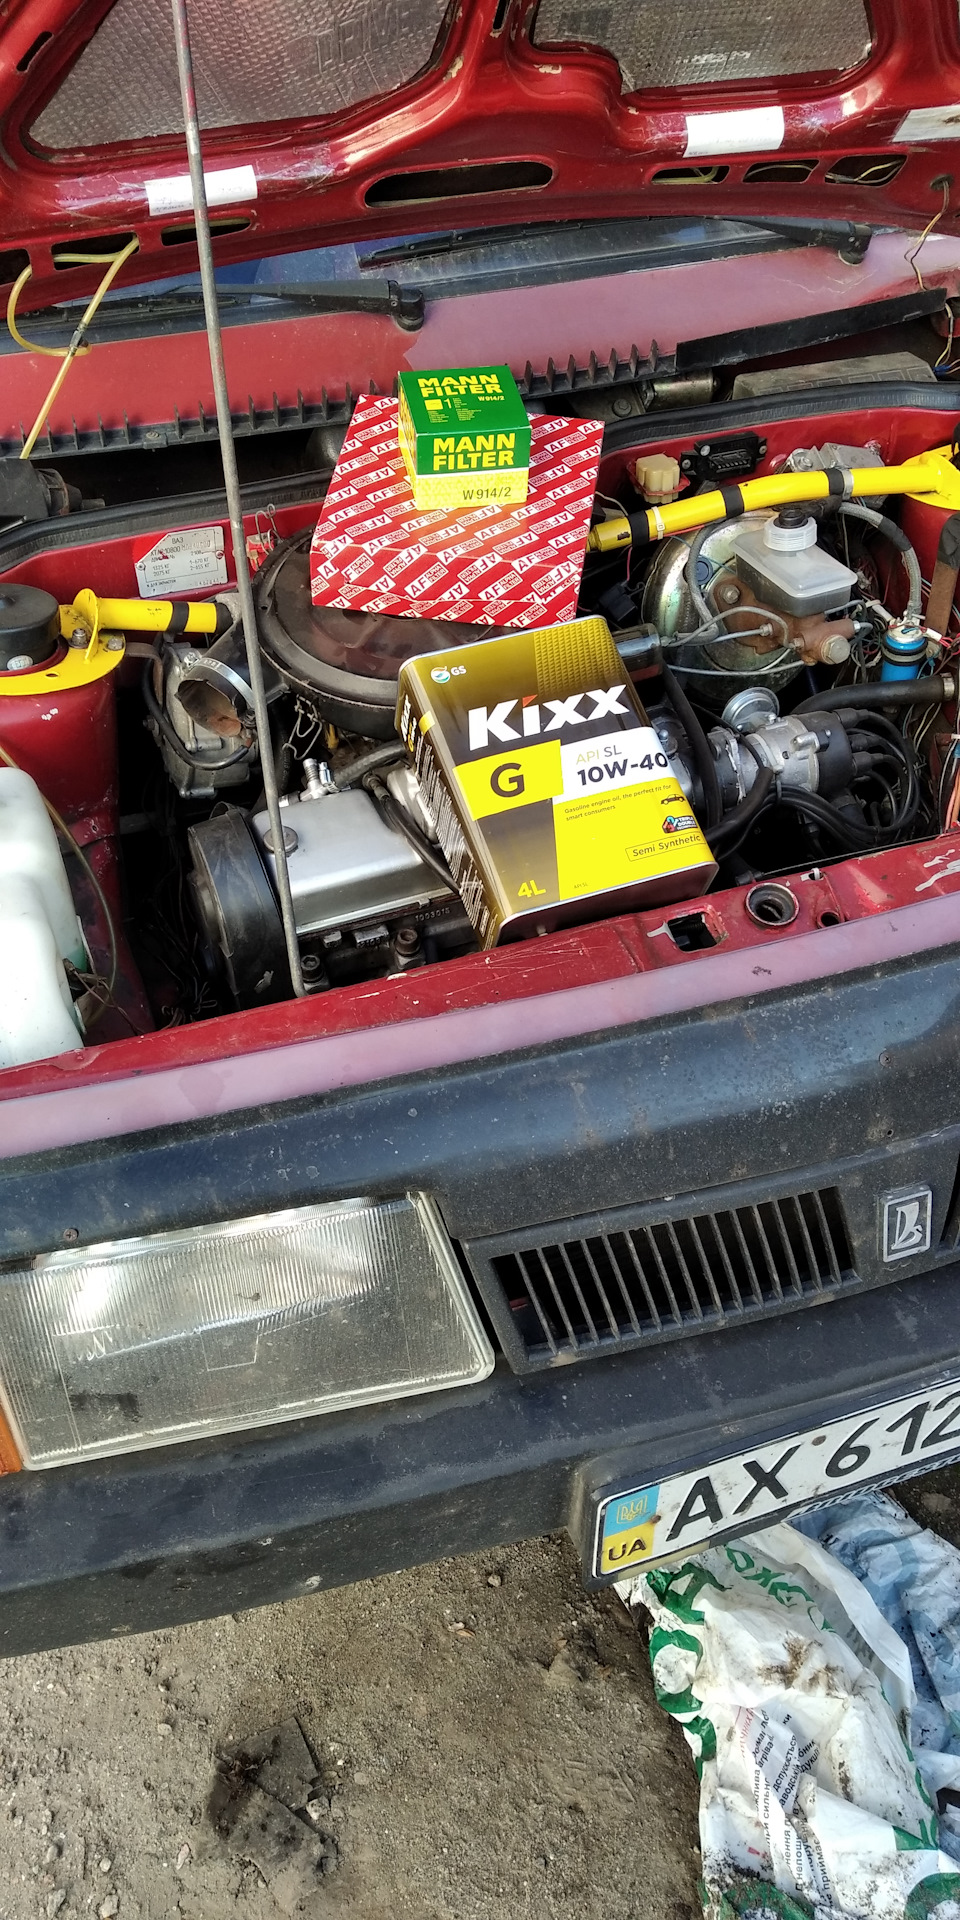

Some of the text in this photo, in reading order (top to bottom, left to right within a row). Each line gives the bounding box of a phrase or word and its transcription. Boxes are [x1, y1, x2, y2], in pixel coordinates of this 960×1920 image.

[418, 374, 498, 388] MANN
[421, 384, 503, 398] FILTER
[433, 433, 516, 454] MANN
[433, 450, 514, 471] FILTER
[450, 665, 466, 676] GS
[468, 684, 630, 751] Kixx
[576, 745, 622, 766] API SL
[577, 751, 668, 787] 10W-40
[490, 763, 525, 798] G
[564, 804, 590, 814] Gasoline
[591, 800, 611, 810] engine
[633, 788, 654, 798] perfect
[587, 805, 616, 817] consumers
[632, 834, 701, 857] Semi Synthetic
[517, 879, 546, 898] 4L
[666, 1444, 802, 1542] AX
[607, 1537, 647, 1561] UA
